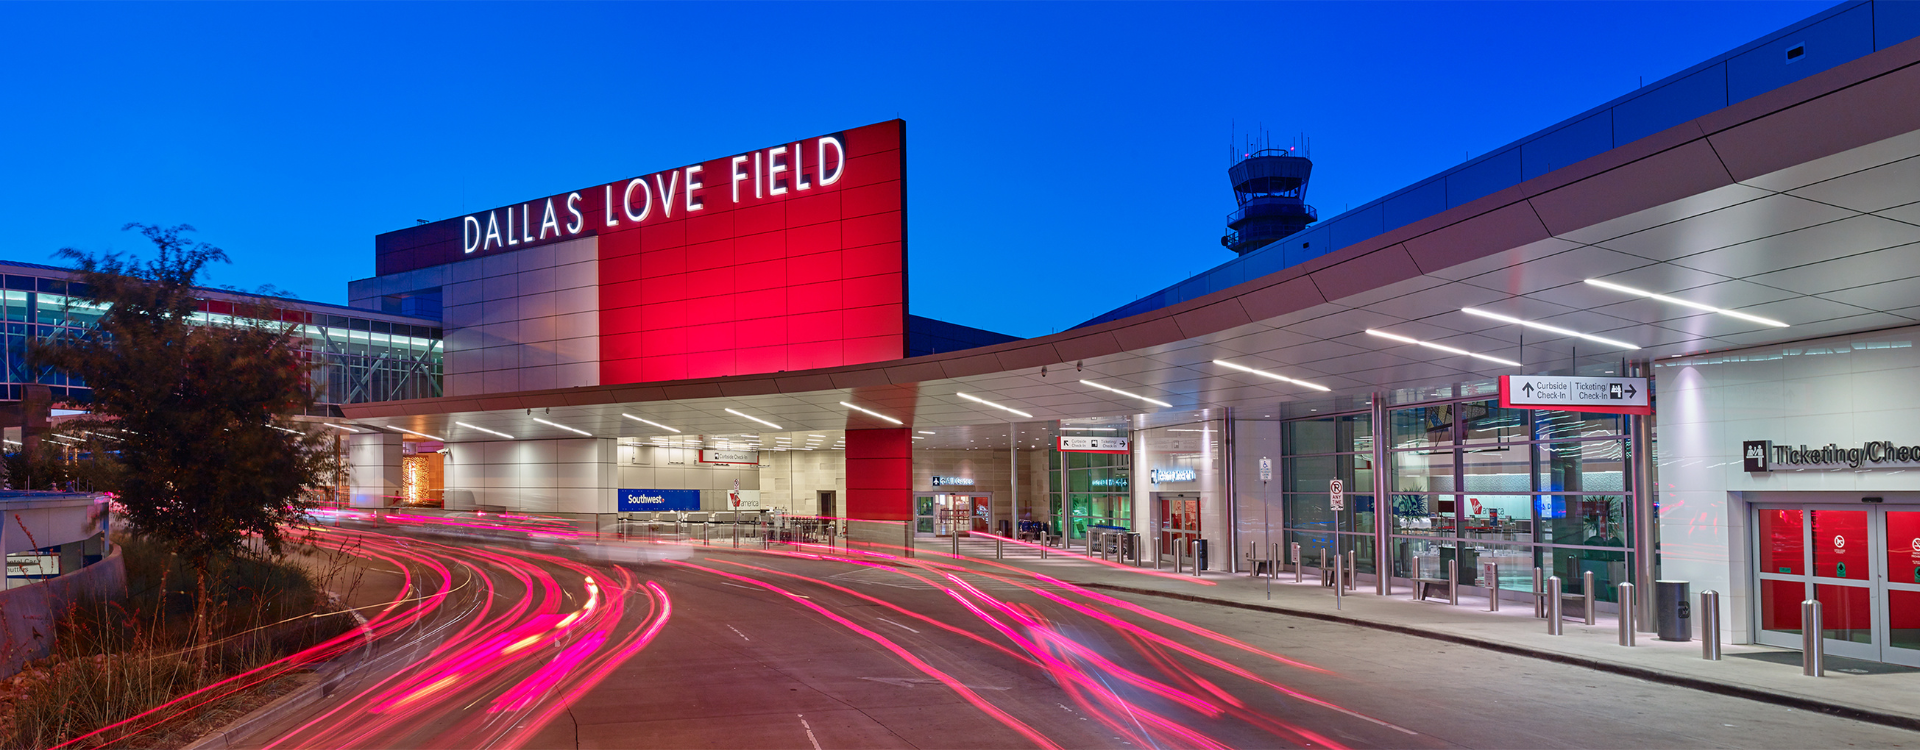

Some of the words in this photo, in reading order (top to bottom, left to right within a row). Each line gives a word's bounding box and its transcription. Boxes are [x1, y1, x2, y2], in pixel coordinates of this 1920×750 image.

[464, 191, 584, 253] DALLAS
[605, 165, 704, 227] LOVE
[732, 136, 845, 203] FIELD
[1537, 381, 1567, 390] Curbside
[1575, 382, 1608, 392] Ticketing/
[1537, 391, 1566, 399] Check-In
[1579, 392, 1608, 400] Check-In
[628, 494, 662, 504] Southwest
